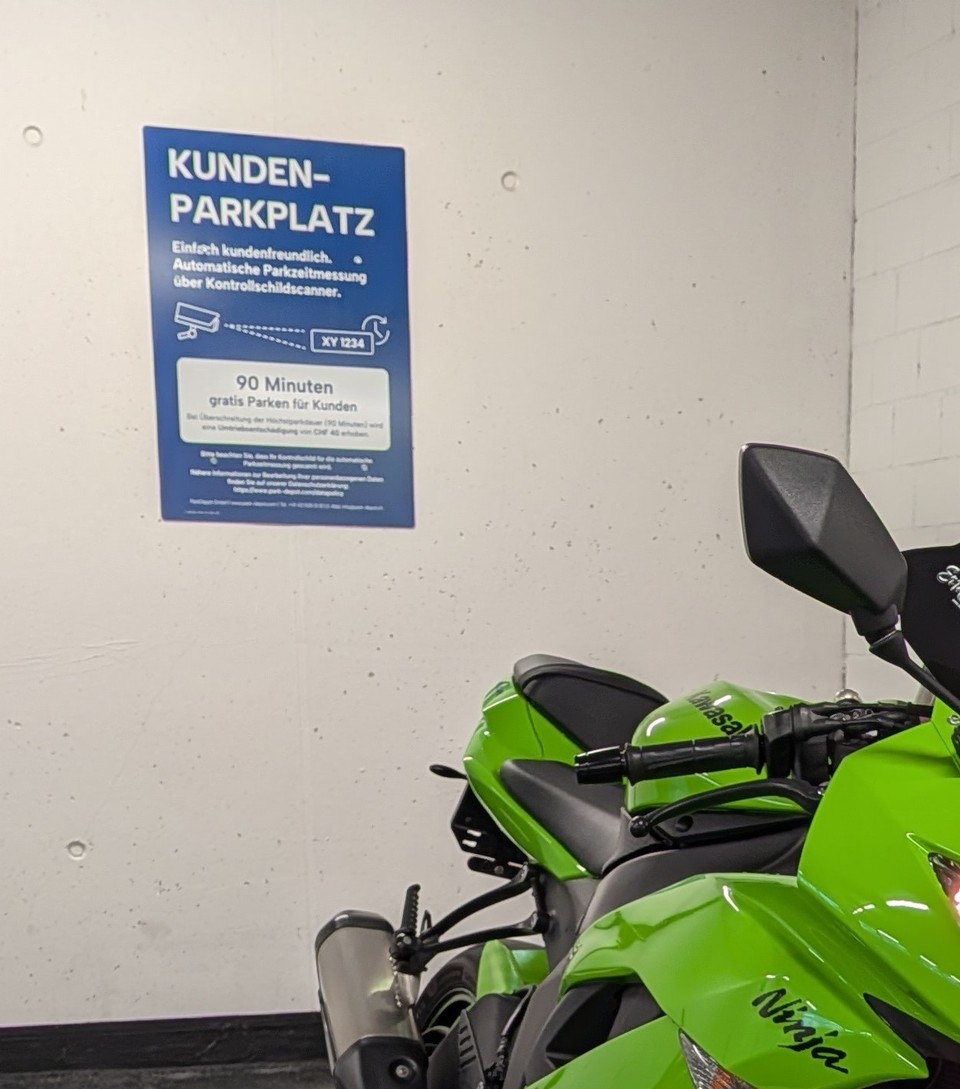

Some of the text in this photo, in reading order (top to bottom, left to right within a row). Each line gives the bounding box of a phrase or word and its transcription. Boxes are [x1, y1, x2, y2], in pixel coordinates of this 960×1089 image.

[167, 147, 331, 189] KUNDEN-
[169, 193, 376, 237] PARKPLATZ
[171, 240, 333, 264] Einfach kundenfreundlich.
[172, 258, 368, 285] Automatische Parkzeitmessung
[173, 275, 342, 298] über Kontrollschildscanner.
[321, 336, 365, 349] XY 1234
[236, 375, 334, 395] 90 Minuten
[209, 395, 358, 412] gratis Parken für Kunden
[751, 988, 849, 1074] Ninja
